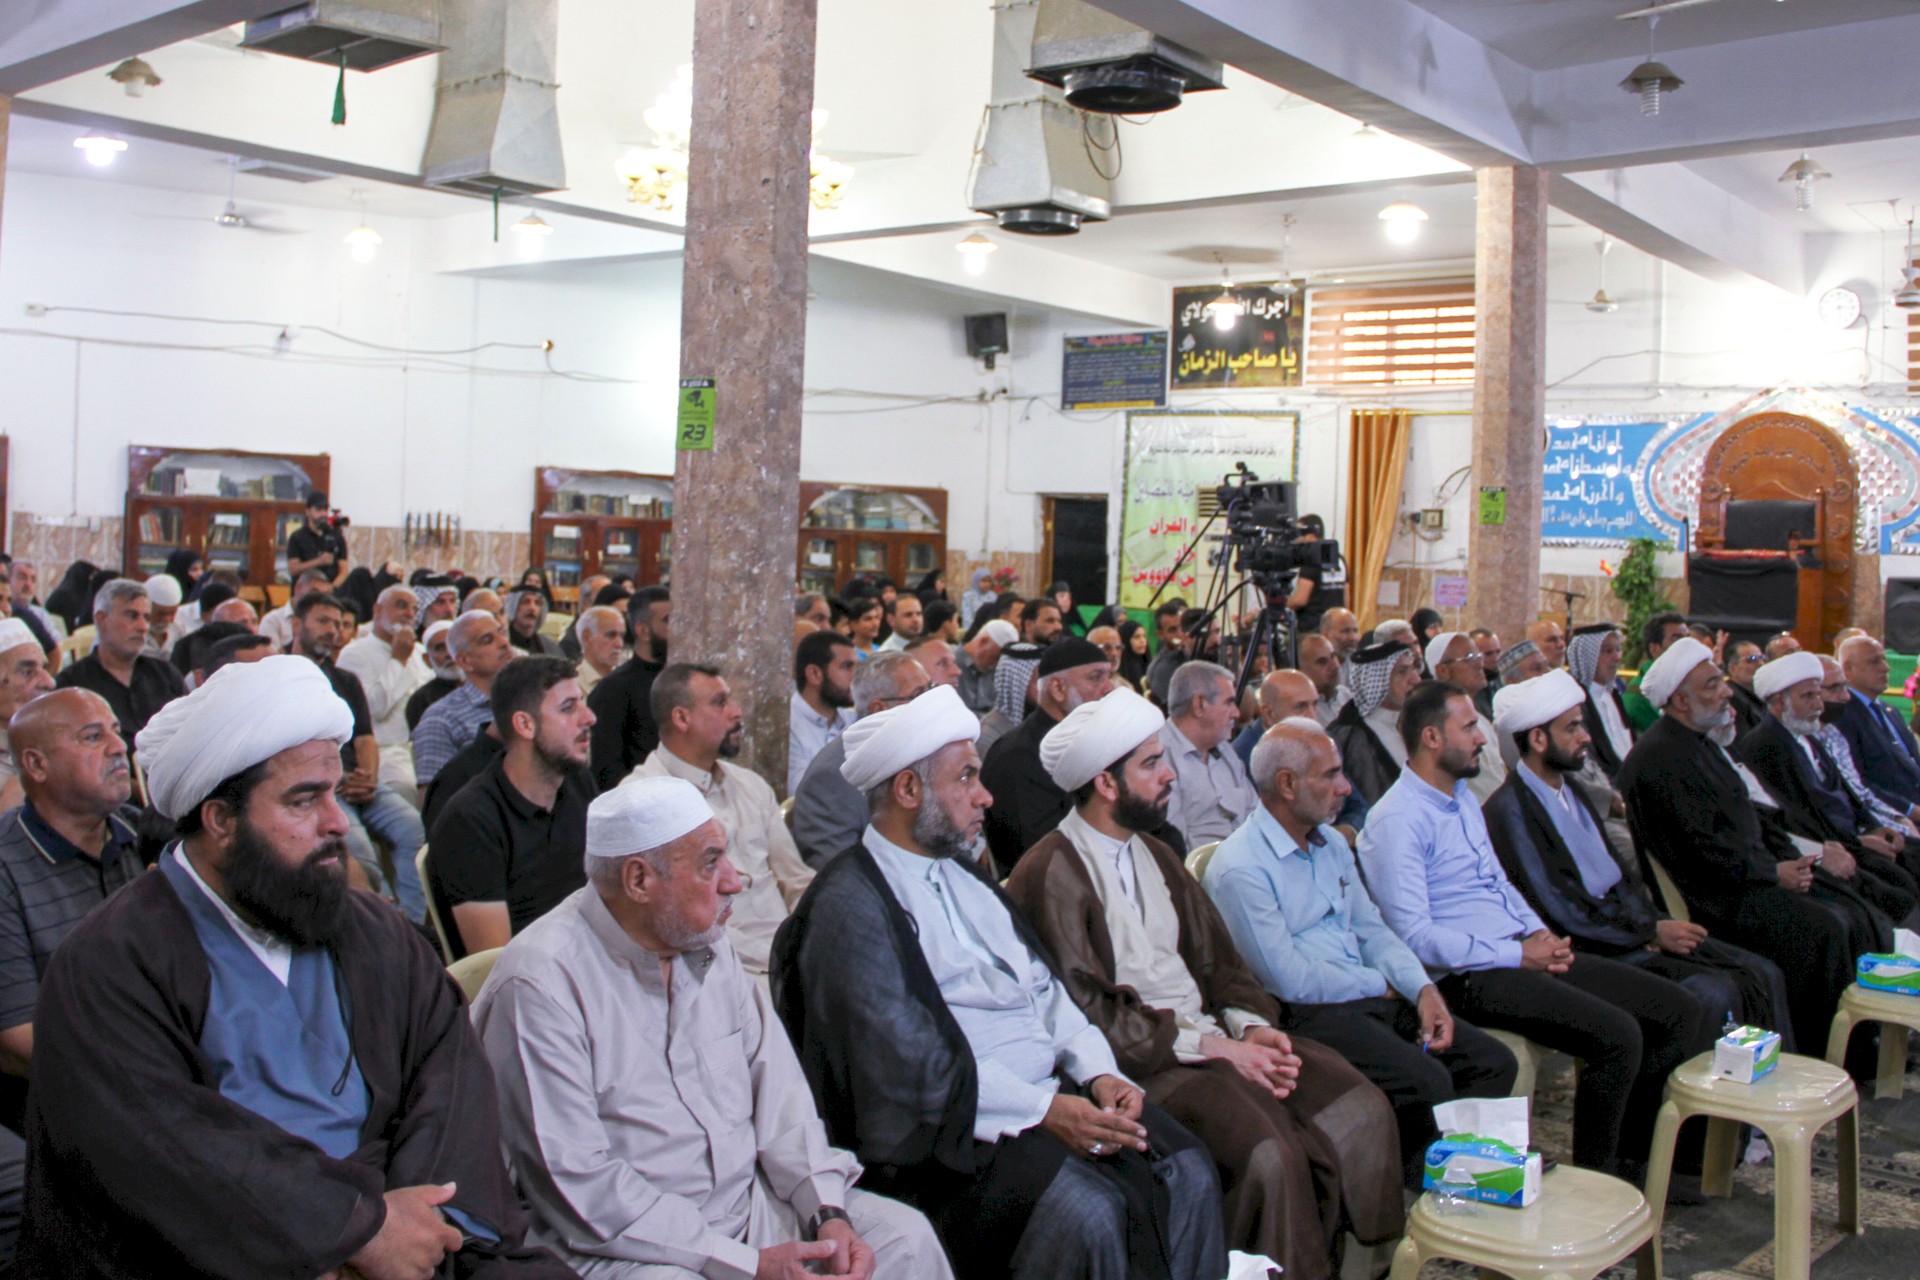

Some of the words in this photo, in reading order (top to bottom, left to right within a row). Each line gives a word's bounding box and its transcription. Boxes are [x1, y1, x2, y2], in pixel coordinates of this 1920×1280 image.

[1178, 350, 1226, 377] الزمان
[1227, 348, 1278, 374] صاحب
[1280, 346, 1297, 374] يا
